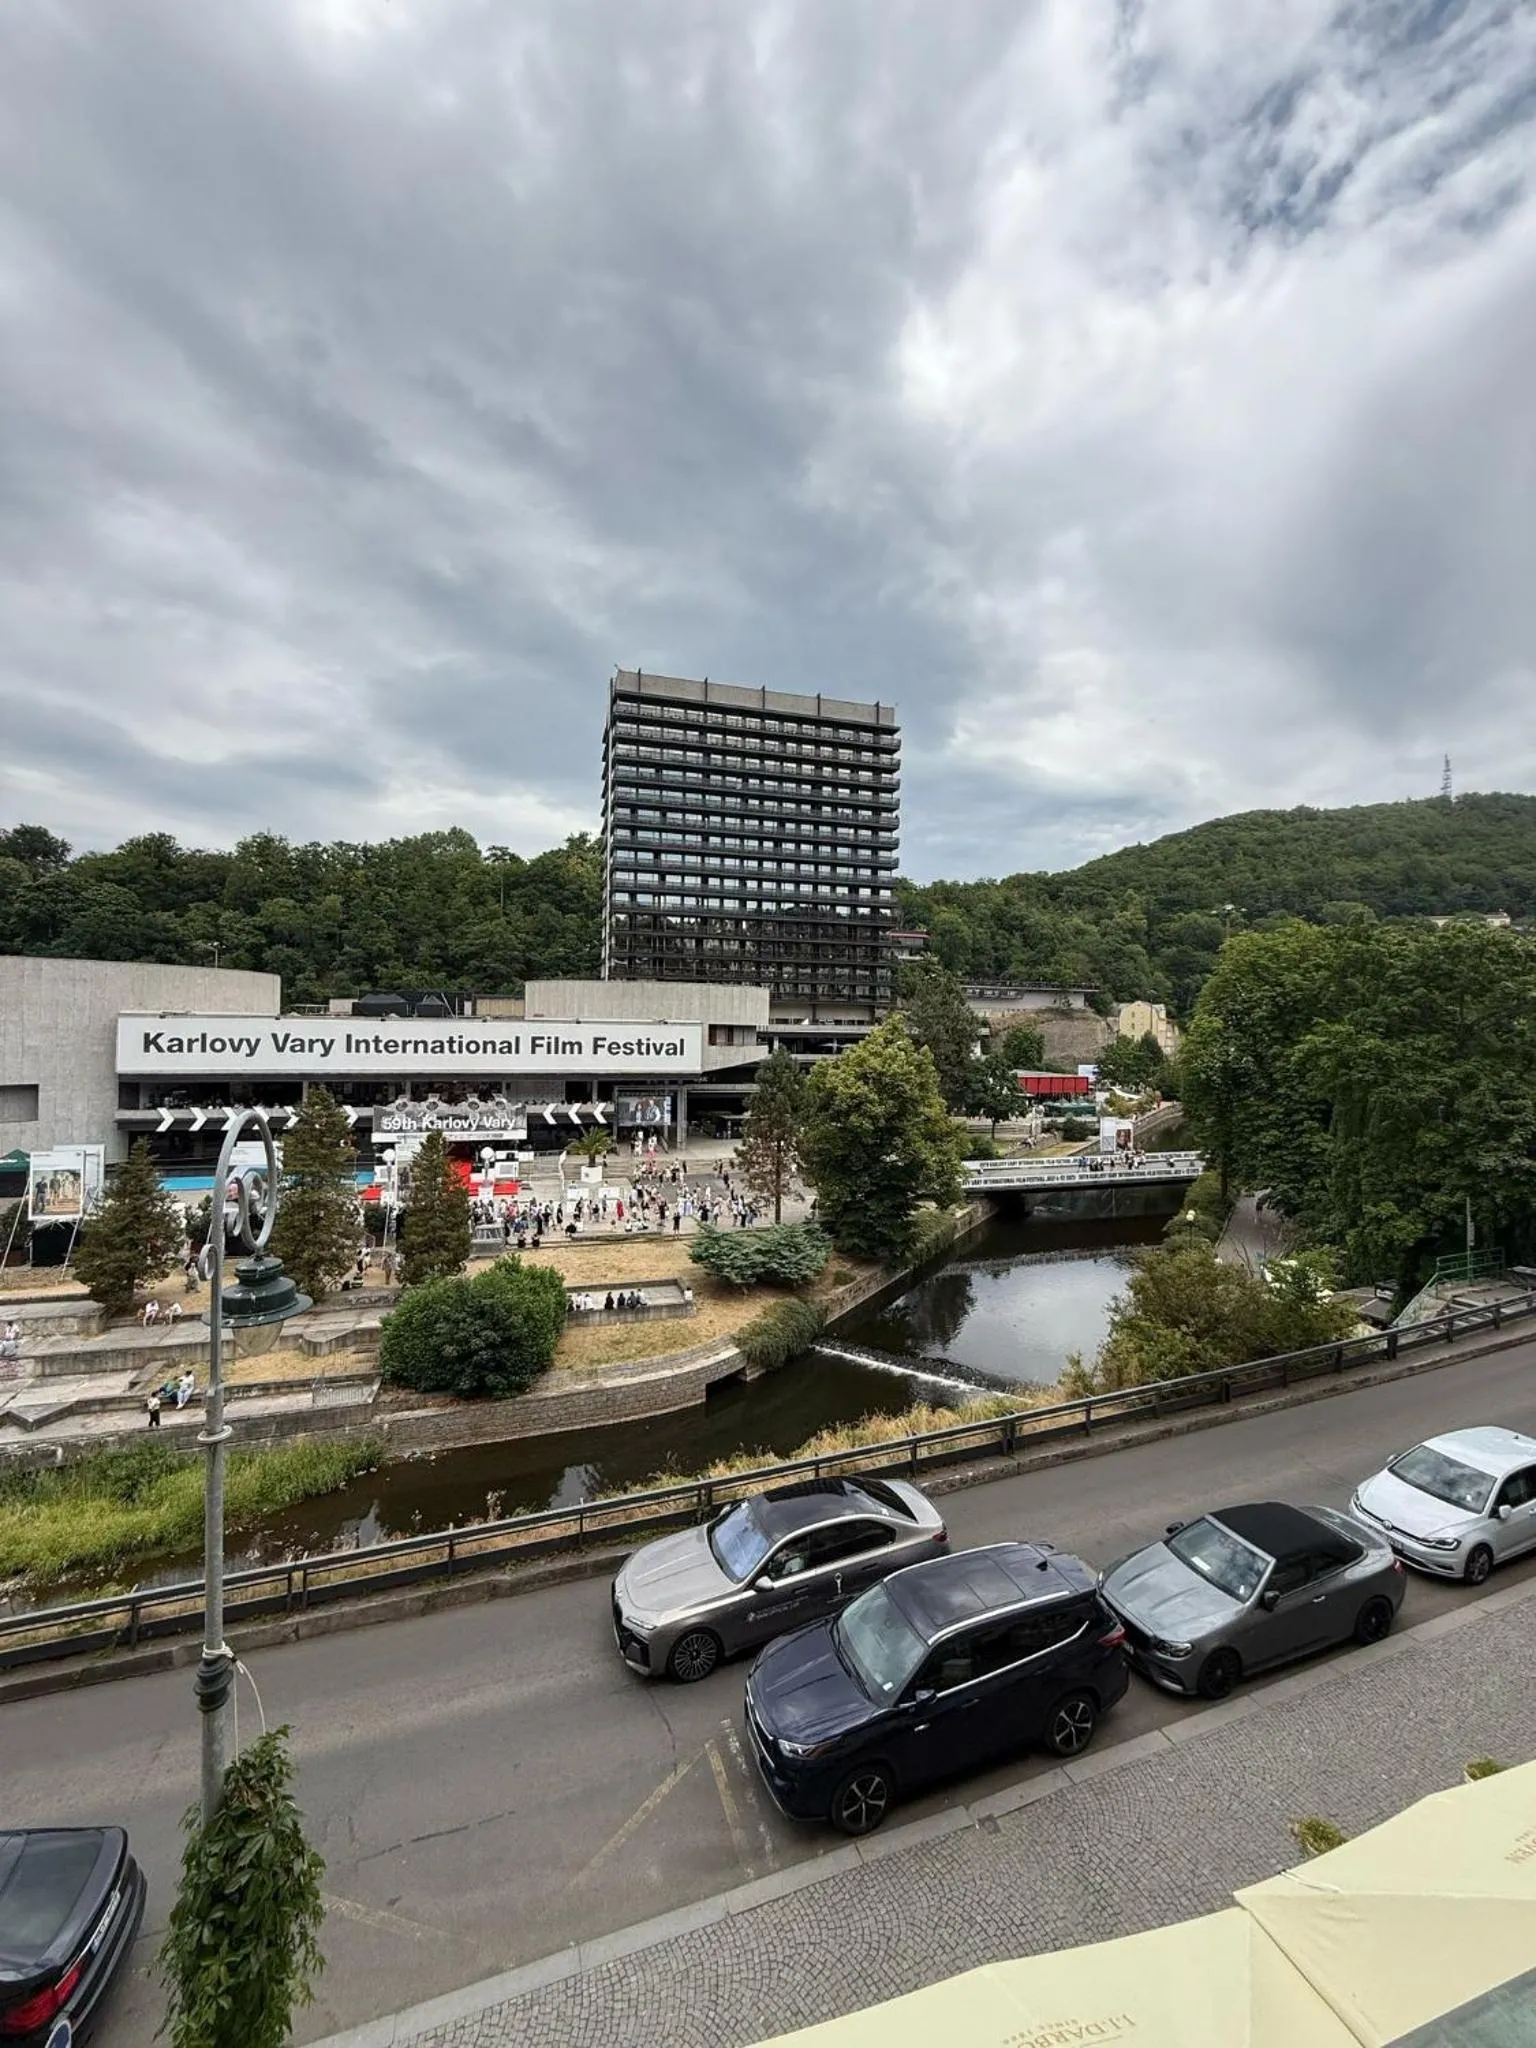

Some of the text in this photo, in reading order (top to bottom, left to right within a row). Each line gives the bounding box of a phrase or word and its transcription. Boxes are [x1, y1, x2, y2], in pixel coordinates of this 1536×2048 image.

[143, 1032, 685, 1058] Karlovy Vary International Film Festival
[382, 1115, 516, 1131] 59th Karlovy Vary
